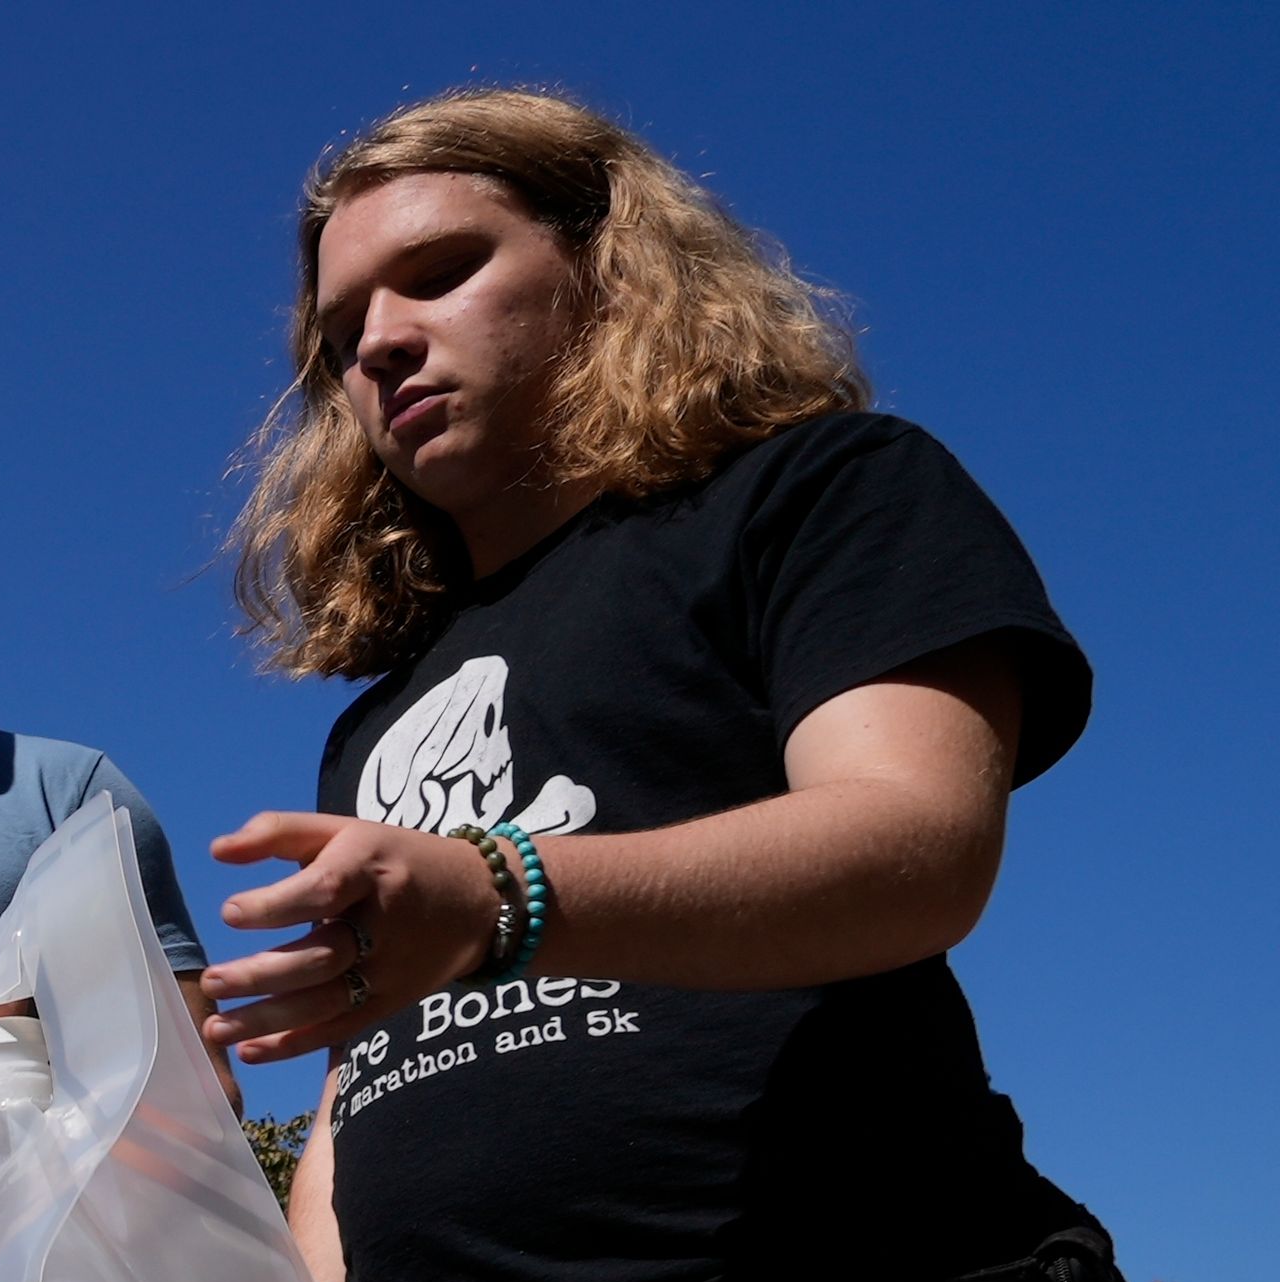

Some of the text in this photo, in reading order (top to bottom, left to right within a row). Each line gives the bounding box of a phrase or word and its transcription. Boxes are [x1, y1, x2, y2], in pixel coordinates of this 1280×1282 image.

[350, 1008, 640, 1117] marathon and 5k
